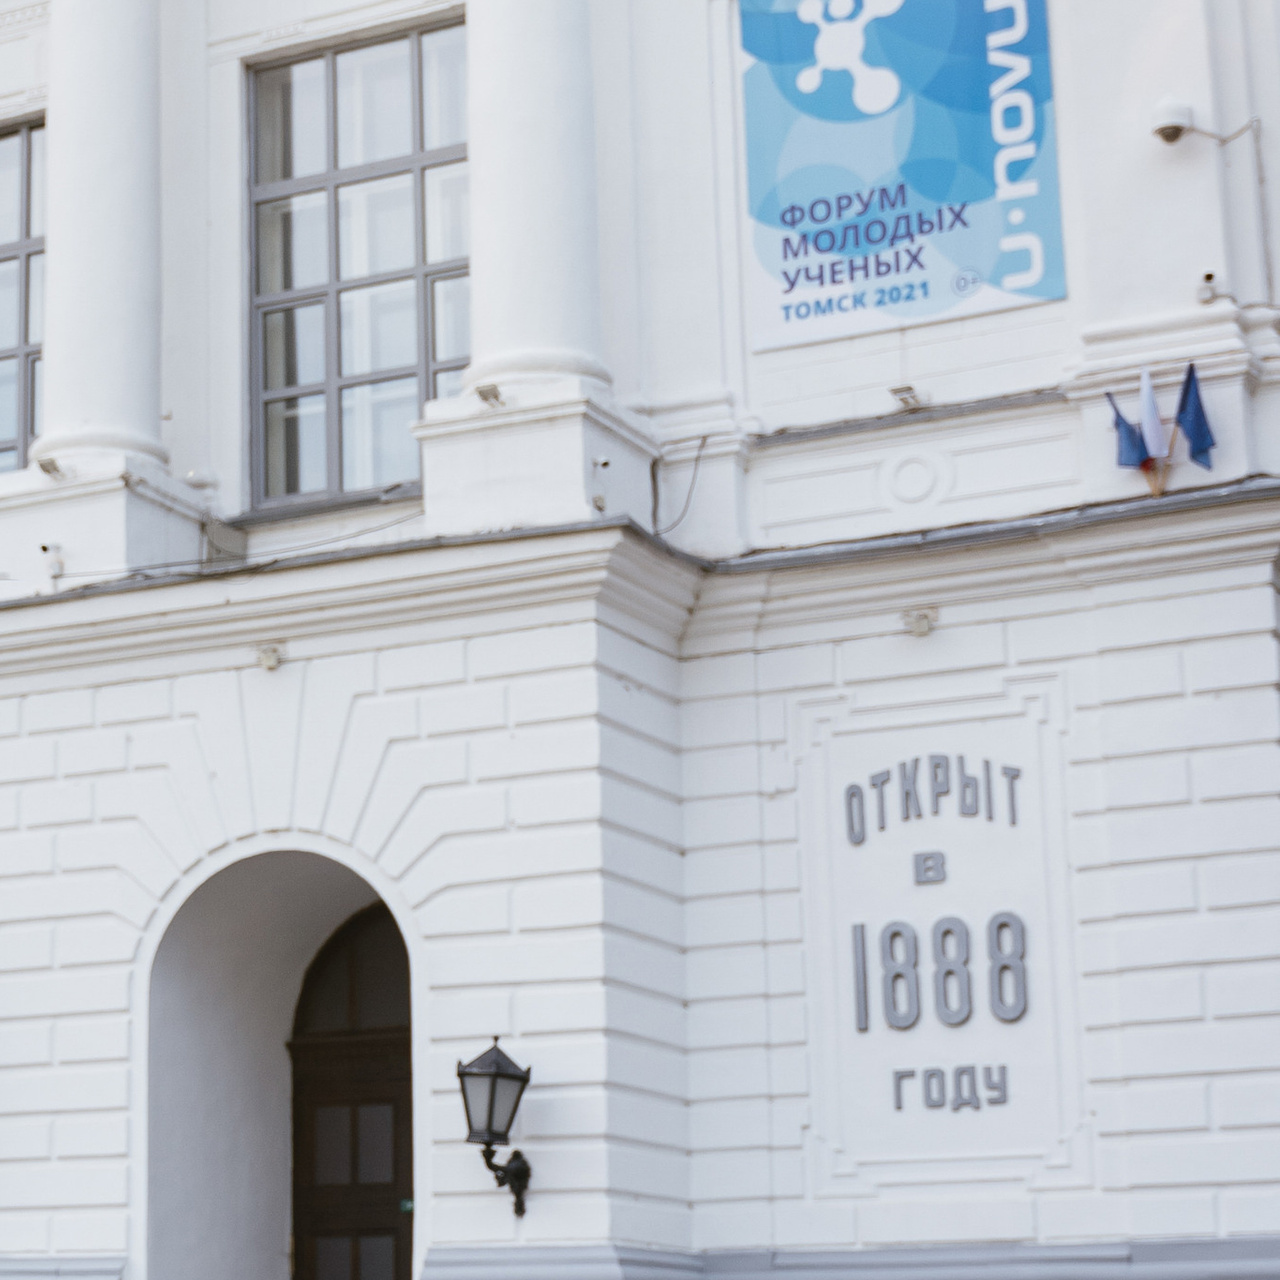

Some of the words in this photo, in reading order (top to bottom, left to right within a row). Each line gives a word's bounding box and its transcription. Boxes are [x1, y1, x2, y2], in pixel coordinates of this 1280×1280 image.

[780, 183, 907, 229] ФОРУМ
[781, 203, 969, 261] МОЛОДЫХ
[781, 246, 926, 294] УЧЕНЫХ
[781, 291, 868, 322] ТОМСК
[874, 280, 930, 307] 2021
[844, 755, 1021, 845] ОТКРЫТ
[913, 851, 946, 885] В
[852, 911, 1029, 1033] 1888
[893, 1066, 1008, 1111] ГОДУ
